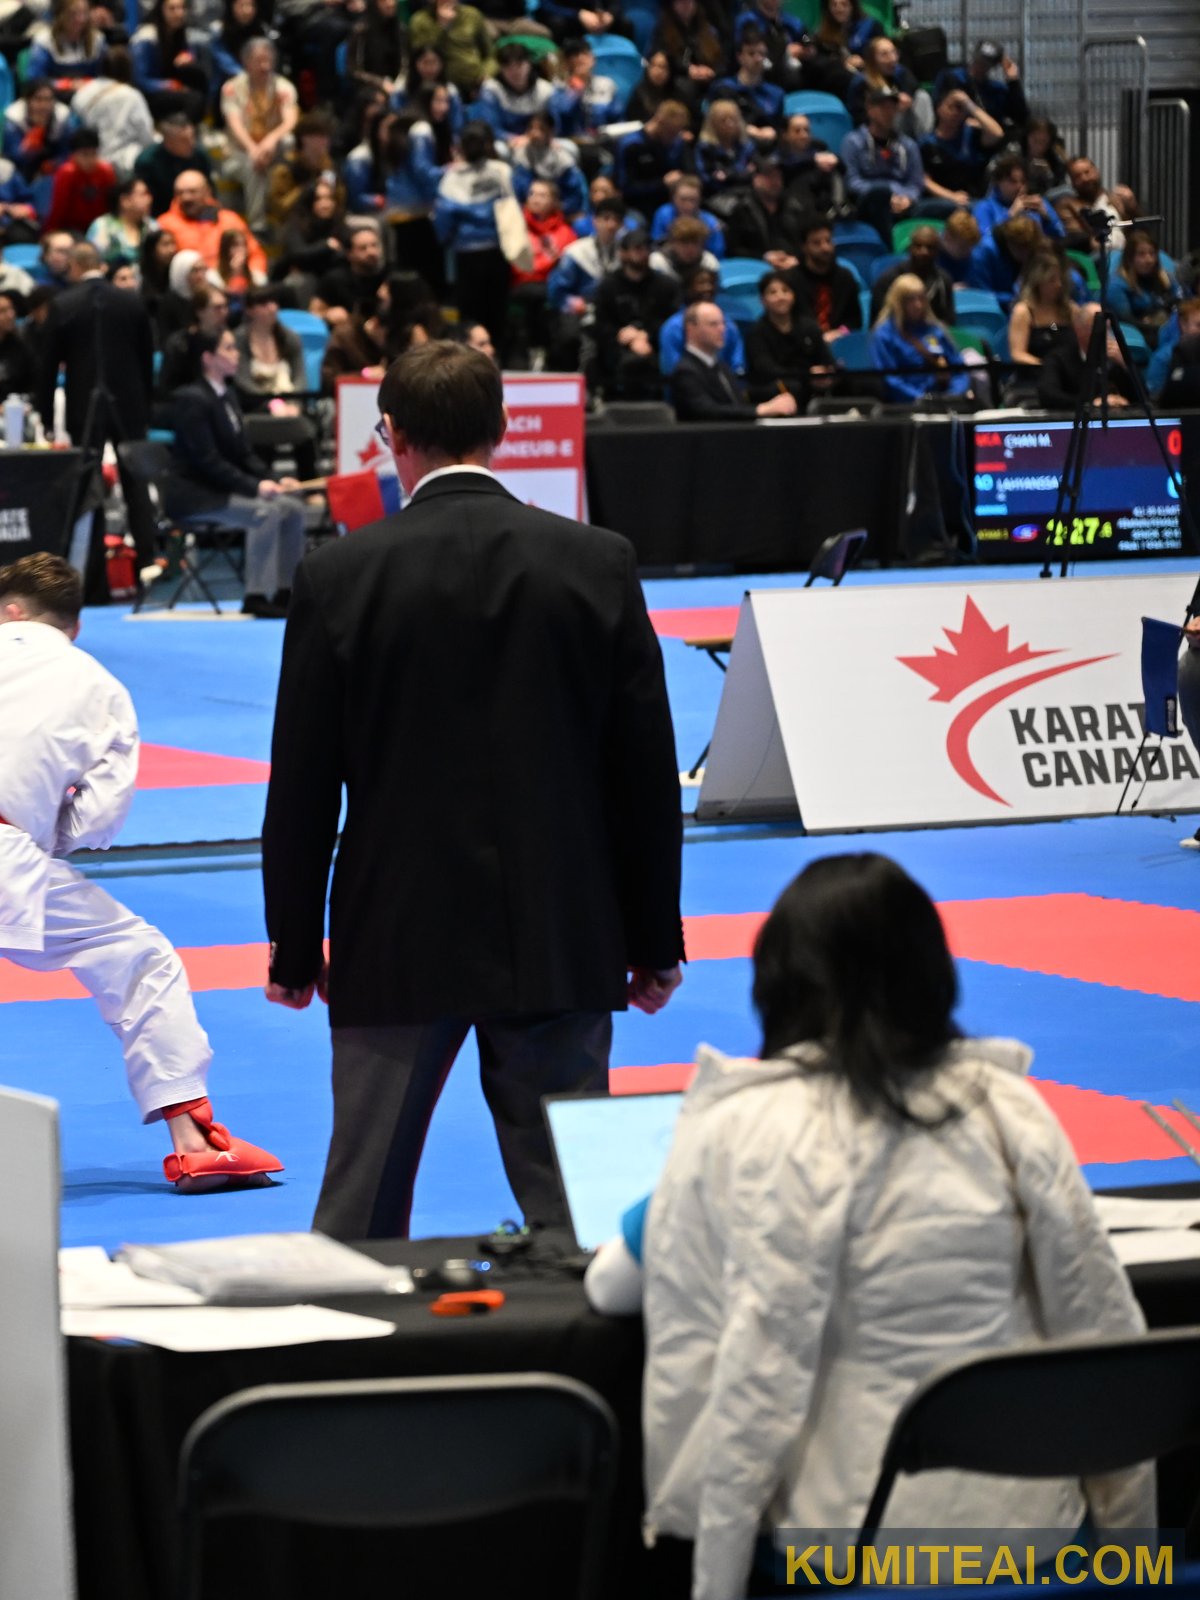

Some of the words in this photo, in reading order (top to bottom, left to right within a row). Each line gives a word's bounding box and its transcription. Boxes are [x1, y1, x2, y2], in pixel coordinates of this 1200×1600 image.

[506, 415, 542, 433] ACH
[1009, 703, 1184, 746] KARAT
[1021, 744, 1200, 788] CANADA
